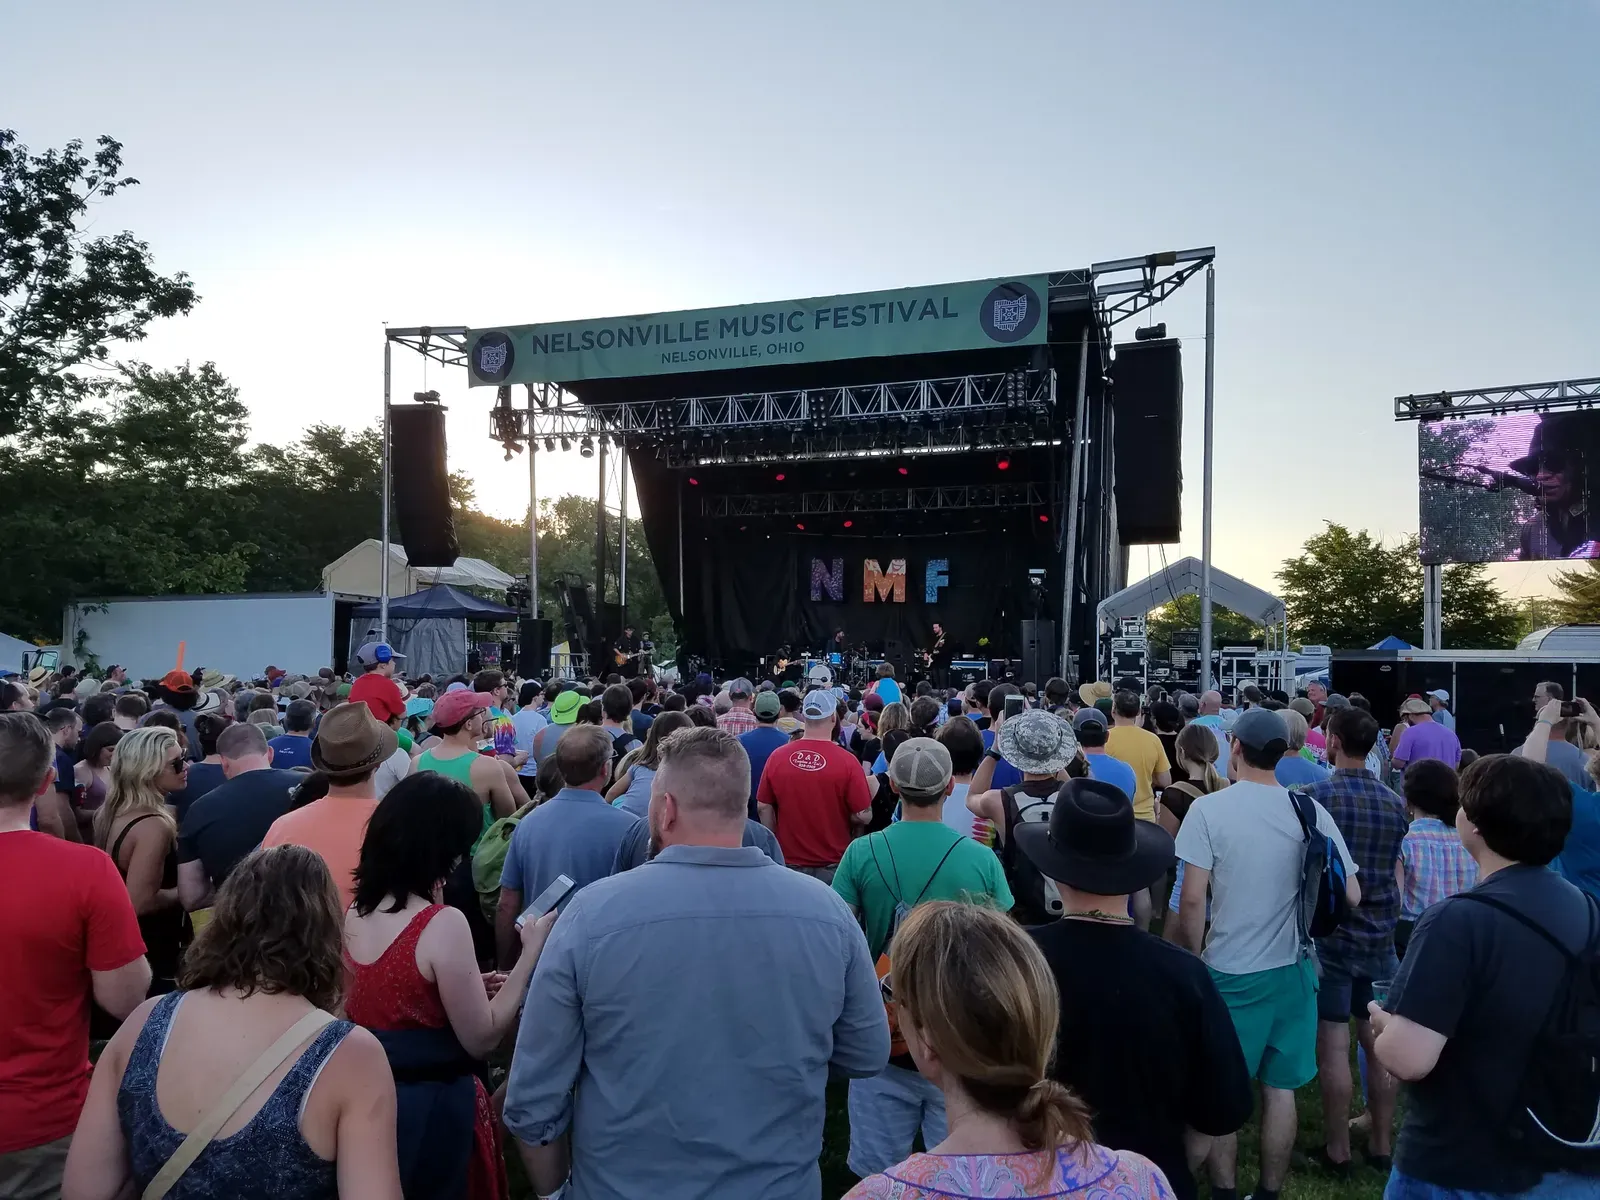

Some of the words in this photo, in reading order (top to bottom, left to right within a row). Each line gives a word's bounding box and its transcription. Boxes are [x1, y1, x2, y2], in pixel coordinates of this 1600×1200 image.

[532, 320, 709, 354] NELSONVILLE
[719, 310, 804, 339] MUSIC
[815, 297, 958, 329] FESTIVAL
[661, 344, 761, 364] NELSONVILLE,
[766, 341, 804, 354] OHIO
